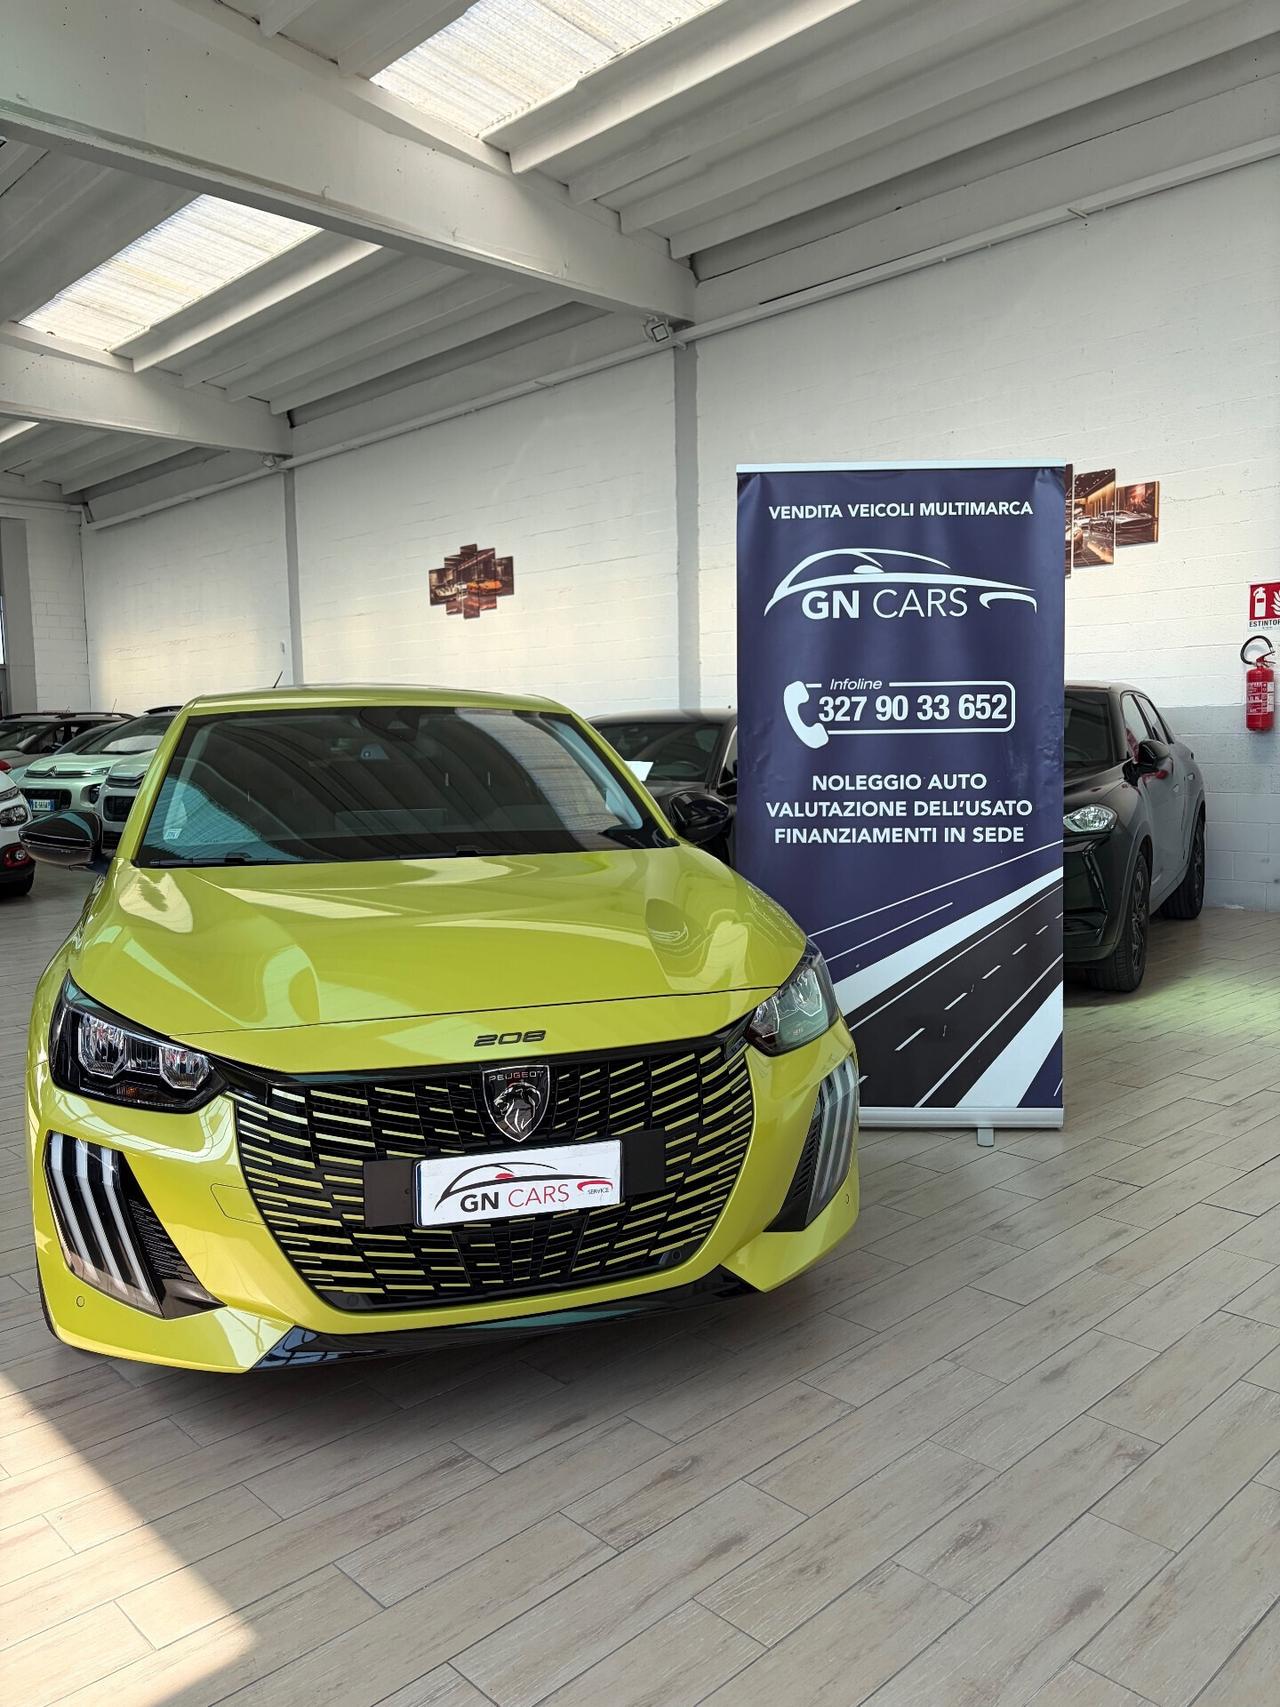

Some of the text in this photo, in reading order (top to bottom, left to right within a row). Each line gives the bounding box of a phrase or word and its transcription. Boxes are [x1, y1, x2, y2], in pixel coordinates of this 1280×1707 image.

[769, 501, 1033, 519] VENDITA VEICOLI MULTIMARCA
[801, 588, 968, 619] GN CARS
[830, 678, 882, 690] Infoline
[818, 694, 1007, 722] 327 90 33 652
[812, 773, 987, 791] NOLEGGIO AUTO
[766, 800, 1033, 817] VALUTAZIONE DELL'USATO
[774, 827, 1025, 843] FINANZIAMENTI IN SEDE
[474, 1030, 546, 1047] 208
[488, 1070, 544, 1082] PEUGEOT
[460, 1183, 570, 1212] GN CARS
[587, 1187, 610, 1195] SERVICE
